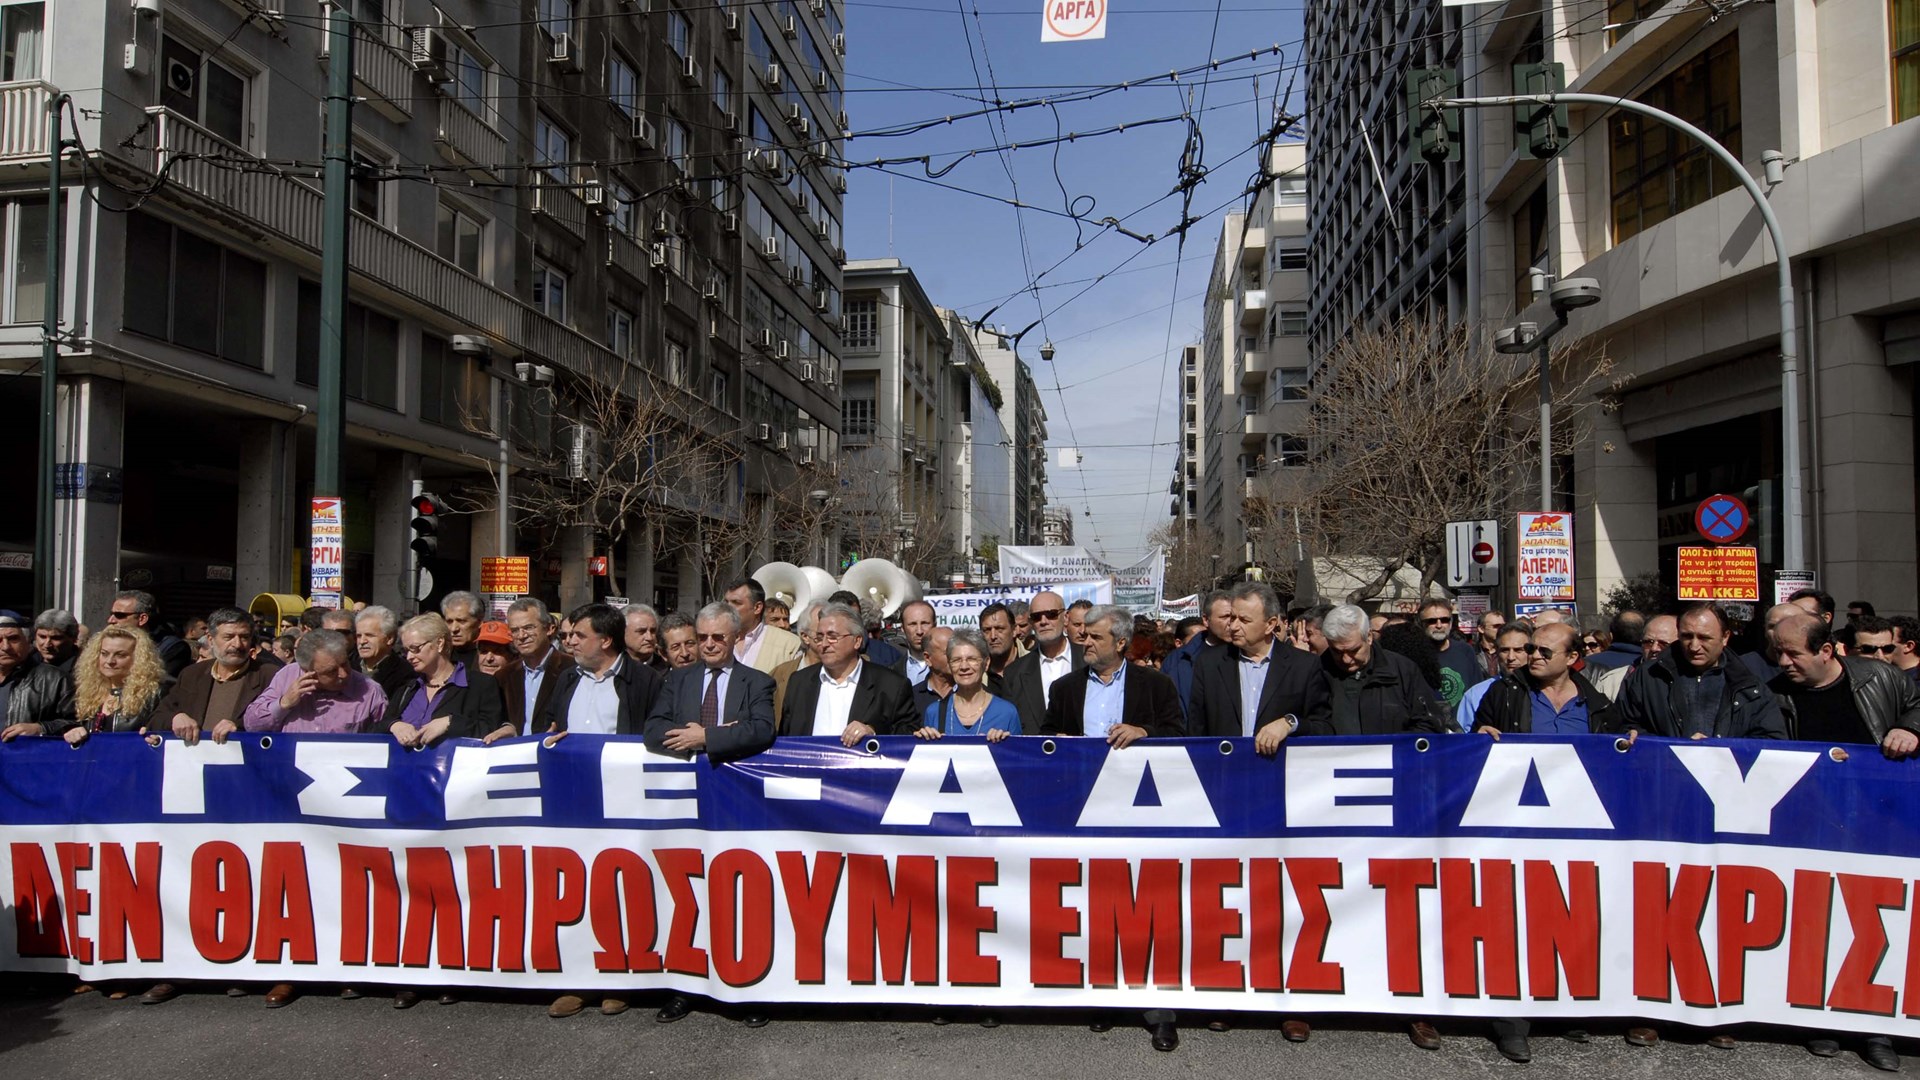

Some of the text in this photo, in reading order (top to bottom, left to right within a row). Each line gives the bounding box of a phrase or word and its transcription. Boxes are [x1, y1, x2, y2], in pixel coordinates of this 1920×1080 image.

[1053, 0, 1095, 20] ΑΡΓΑ
[1680, 549, 1755, 557] ΟΛΟΙ ΣΤΟΝ ΑΓΩΝΑ!
[1051, 557, 1059, 566] Η
[1522, 558, 1568, 574] ΑΠΕΡΓΙΑ
[1009, 566, 1028, 575] ΤΟΥ
[1031, 566, 1080, 576] ΔΗΜΟΣΙΟΥ
[1526, 575, 1543, 584] 24
[1521, 586, 1559, 597] ΟΜΟΝΟΙΑ
[1680, 587, 1743, 598] Μ-Λ ΚΚΕ
[10, 840, 1920, 1021] ΔΕΝ ΘΑ ΠΛΗΡΩΣΟΥΜΕ ΕΜΕΙΣ ΤΗΝ ΚΡΙΣ
